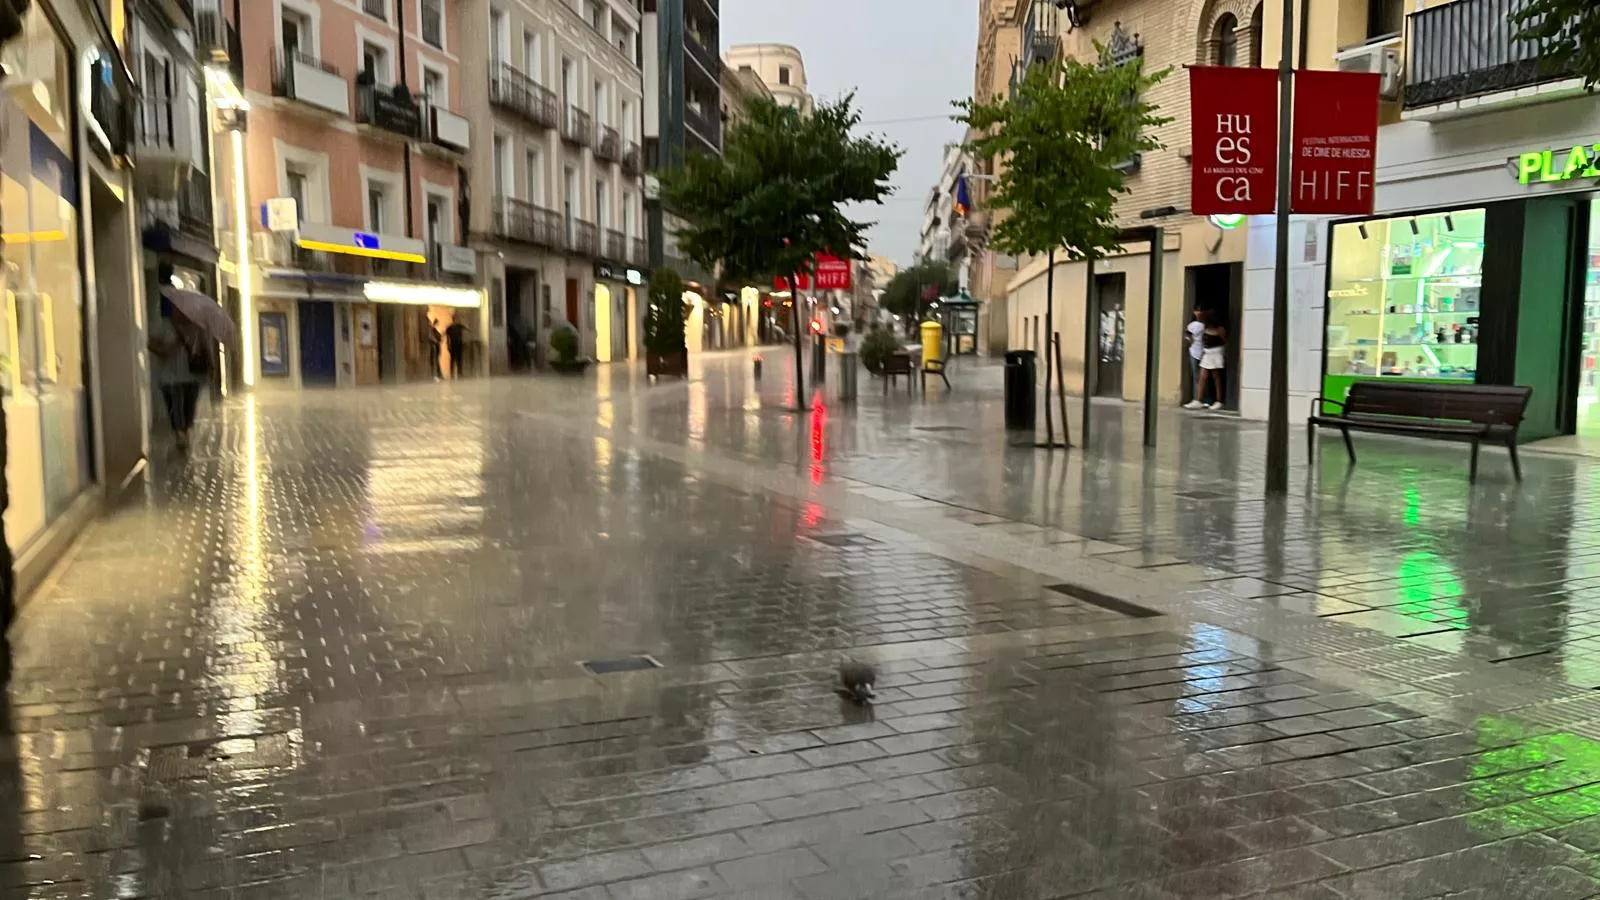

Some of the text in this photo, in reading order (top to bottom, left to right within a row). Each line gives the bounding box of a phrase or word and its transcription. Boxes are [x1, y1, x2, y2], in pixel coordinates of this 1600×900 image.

[1215, 136, 1251, 165] es
[1302, 147, 1371, 158] DE CINE DE HUESCA
[1215, 176, 1252, 202] ca
[1300, 170, 1370, 200] HIFF
[817, 271, 847, 285] HIFF
